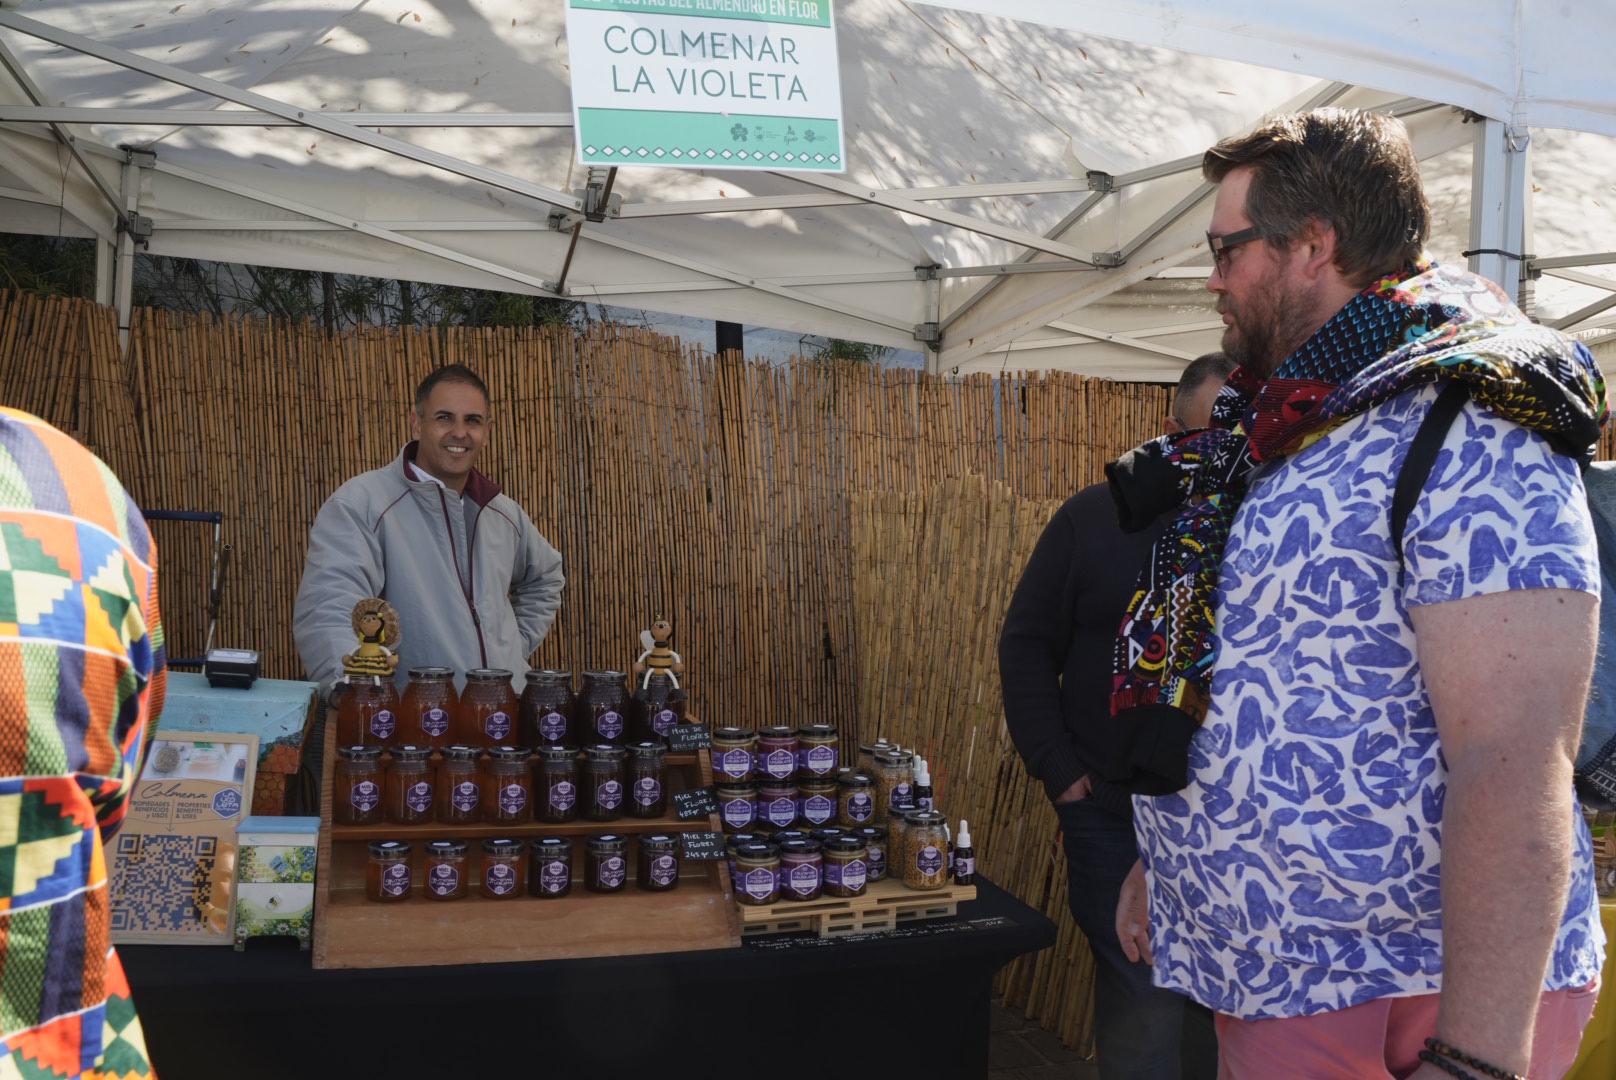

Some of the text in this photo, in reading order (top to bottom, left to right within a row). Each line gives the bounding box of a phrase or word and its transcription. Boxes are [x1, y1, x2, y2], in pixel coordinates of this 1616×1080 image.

[770, 0, 786, 16] EN
[789, 0, 820, 19] FLOR
[604, 25, 800, 65] COLMENAR
[612, 65, 808, 102] LA VIOLETA
[682, 832, 700, 840] MIEL
